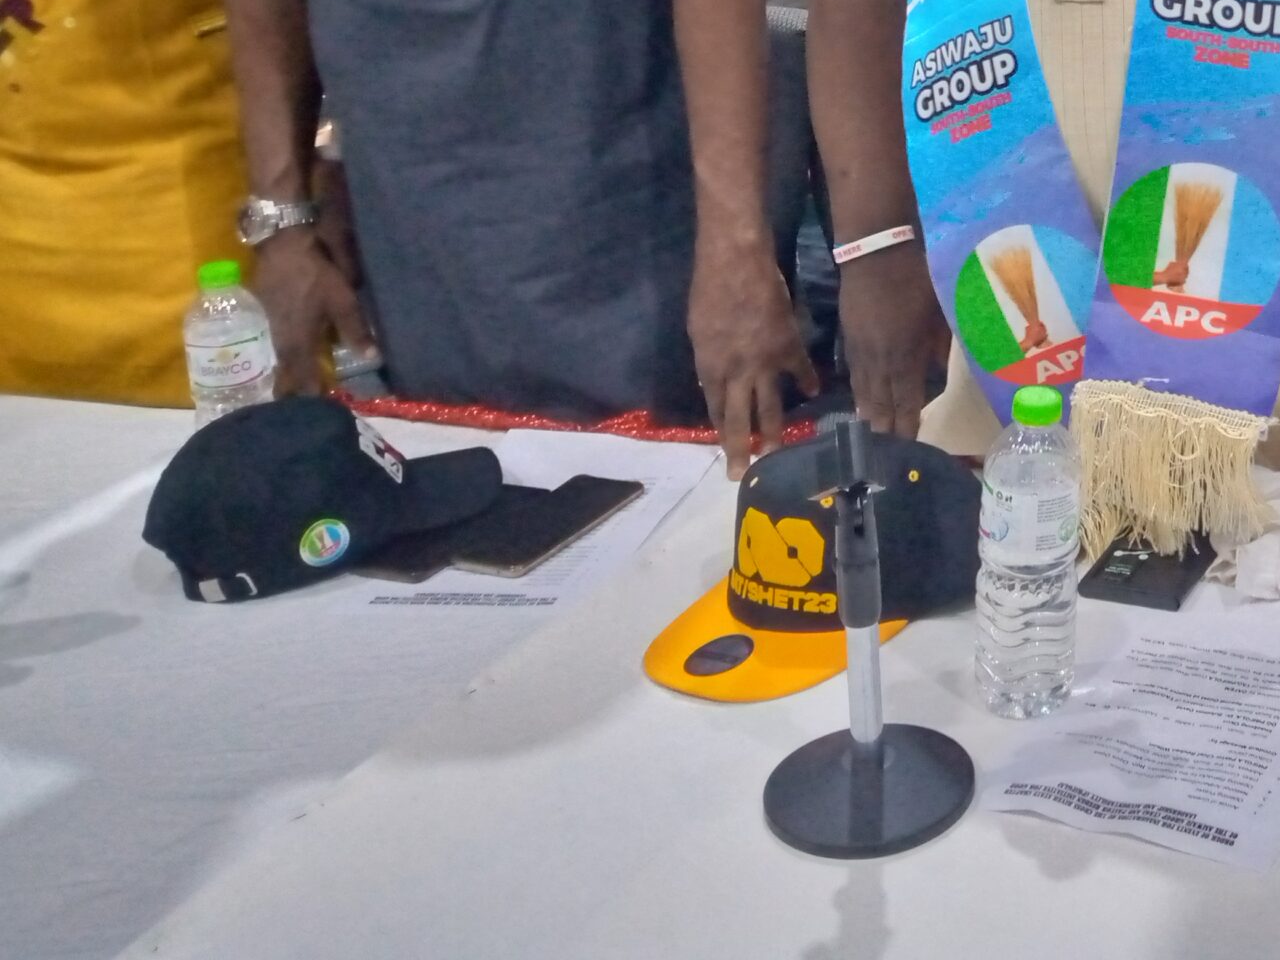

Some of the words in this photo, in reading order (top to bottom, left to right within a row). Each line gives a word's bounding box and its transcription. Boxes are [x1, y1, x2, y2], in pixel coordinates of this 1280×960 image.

[911, 15, 1014, 89] ASIWAJU
[915, 49, 1018, 122] GROUP
[1140, 300, 1228, 335] APC
[201, 360, 252, 377] BRAYCO
